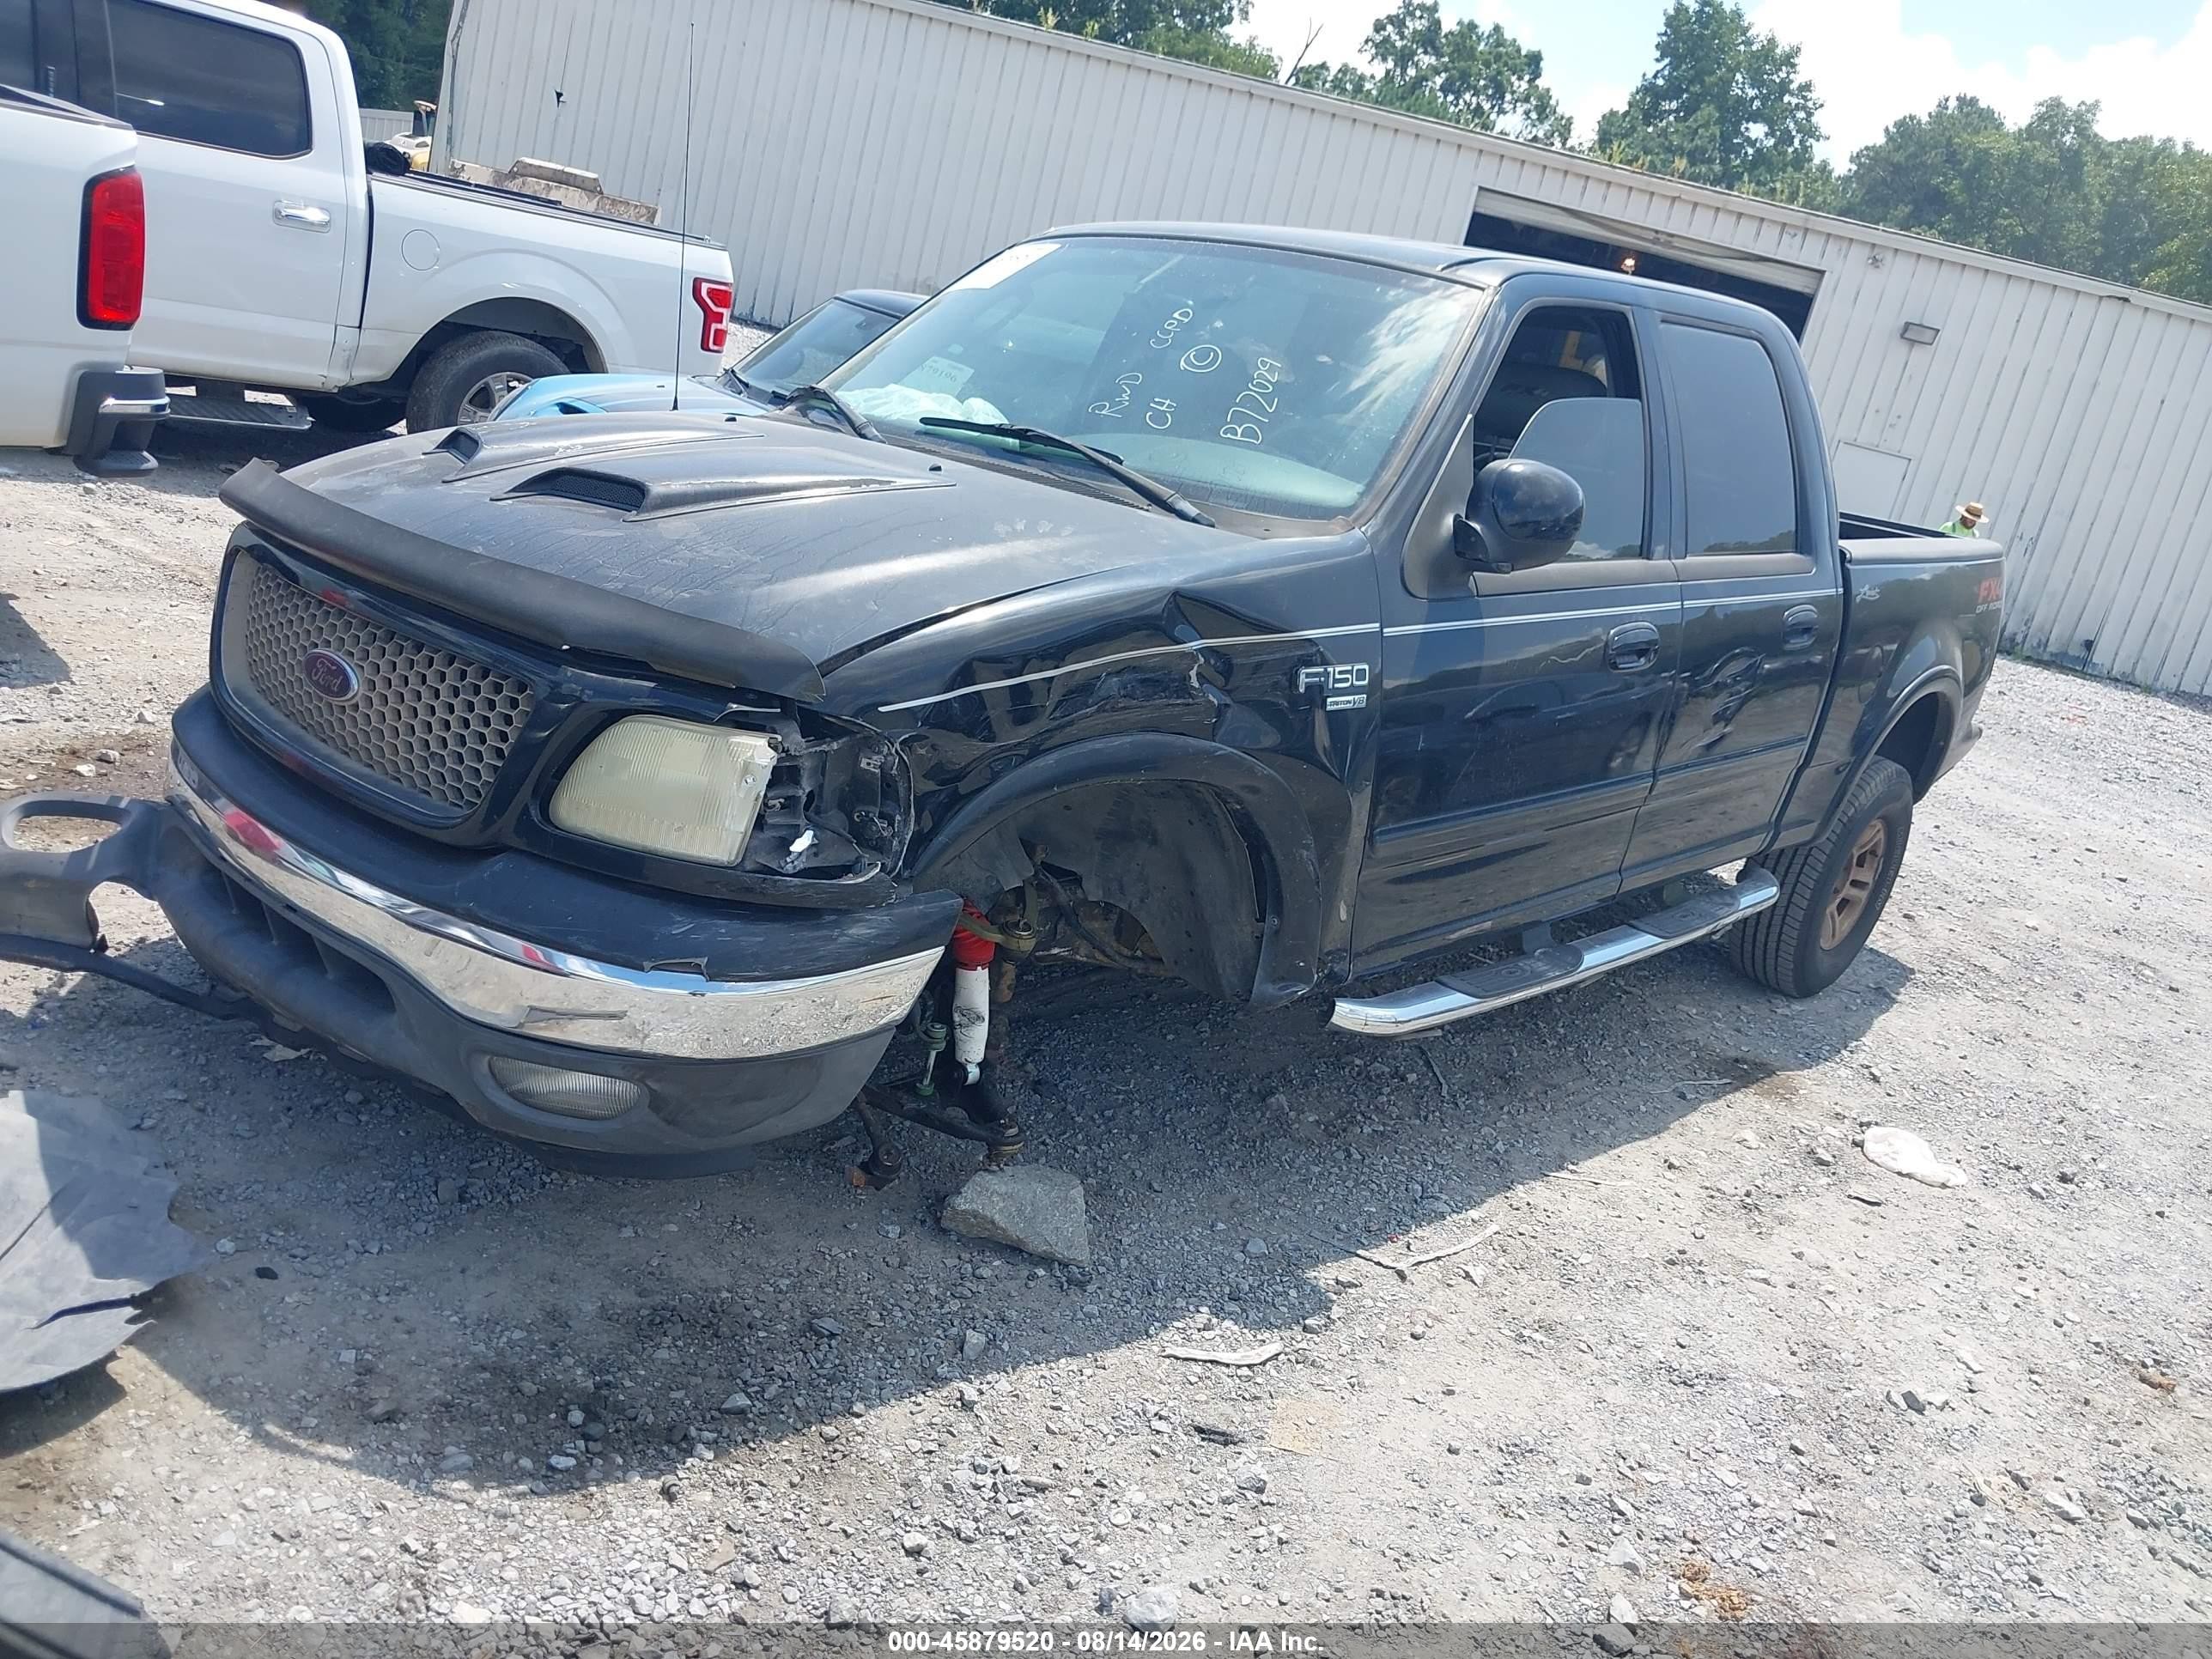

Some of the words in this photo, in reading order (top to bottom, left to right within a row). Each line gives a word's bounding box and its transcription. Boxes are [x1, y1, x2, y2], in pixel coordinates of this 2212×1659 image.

[1146, 398, 1176, 429] CH
[1220, 357, 1281, 444] B72029
[312, 658, 343, 692] Ford
